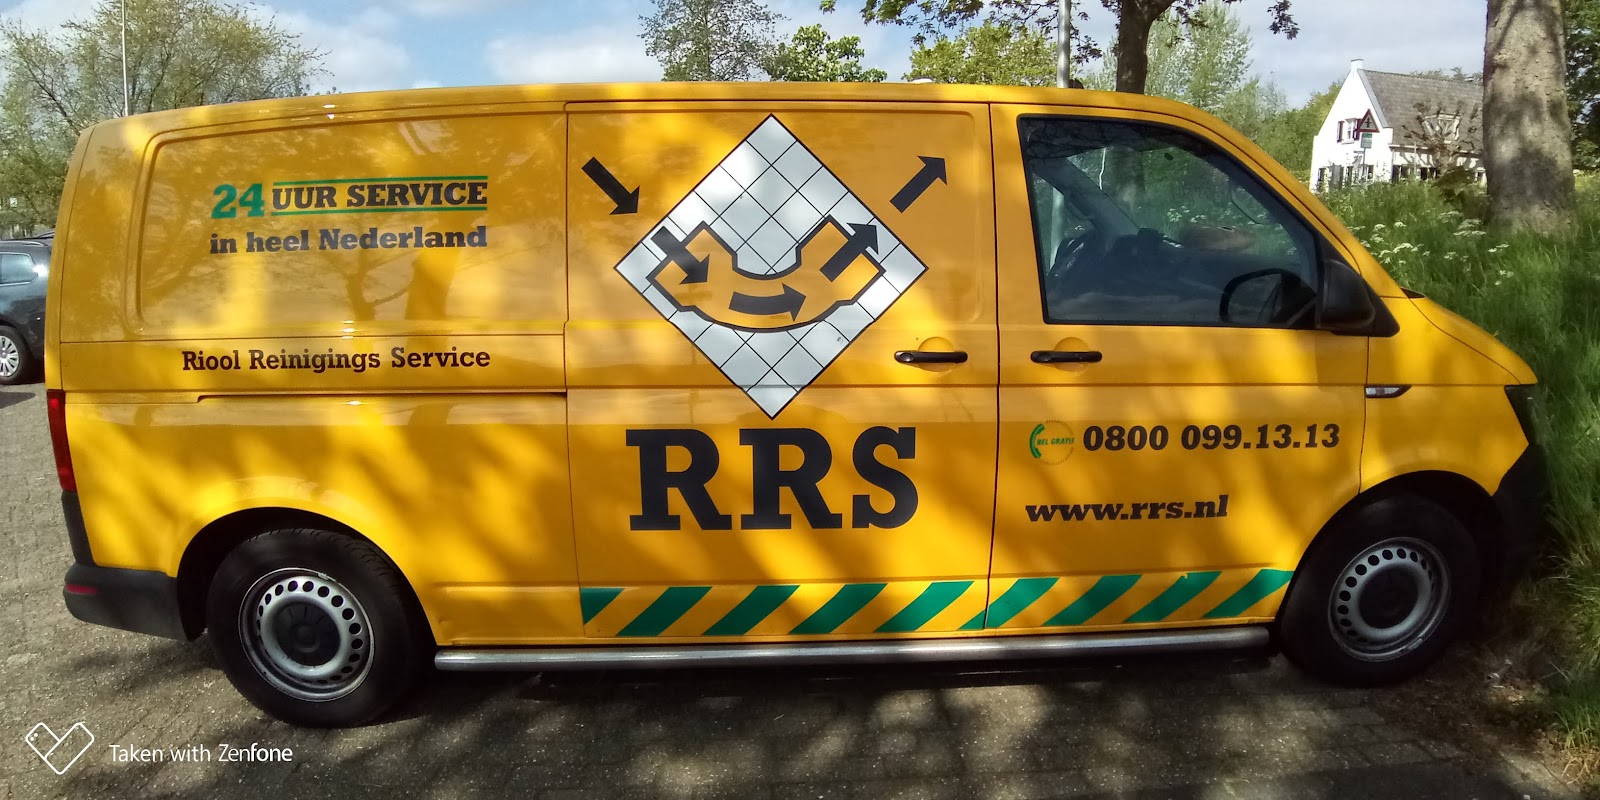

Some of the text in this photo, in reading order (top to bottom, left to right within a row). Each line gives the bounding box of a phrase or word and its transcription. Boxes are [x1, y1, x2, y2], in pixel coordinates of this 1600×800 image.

[211, 182, 488, 219] 24 UUR SERVICE
[210, 226, 488, 254] in heel Nederland
[182, 346, 491, 373] Riool Reinigings Service
[1083, 423, 1340, 451] 0800 099.13.13
[625, 425, 919, 531] RRS
[1025, 495, 1229, 522] www.rrs.nl
